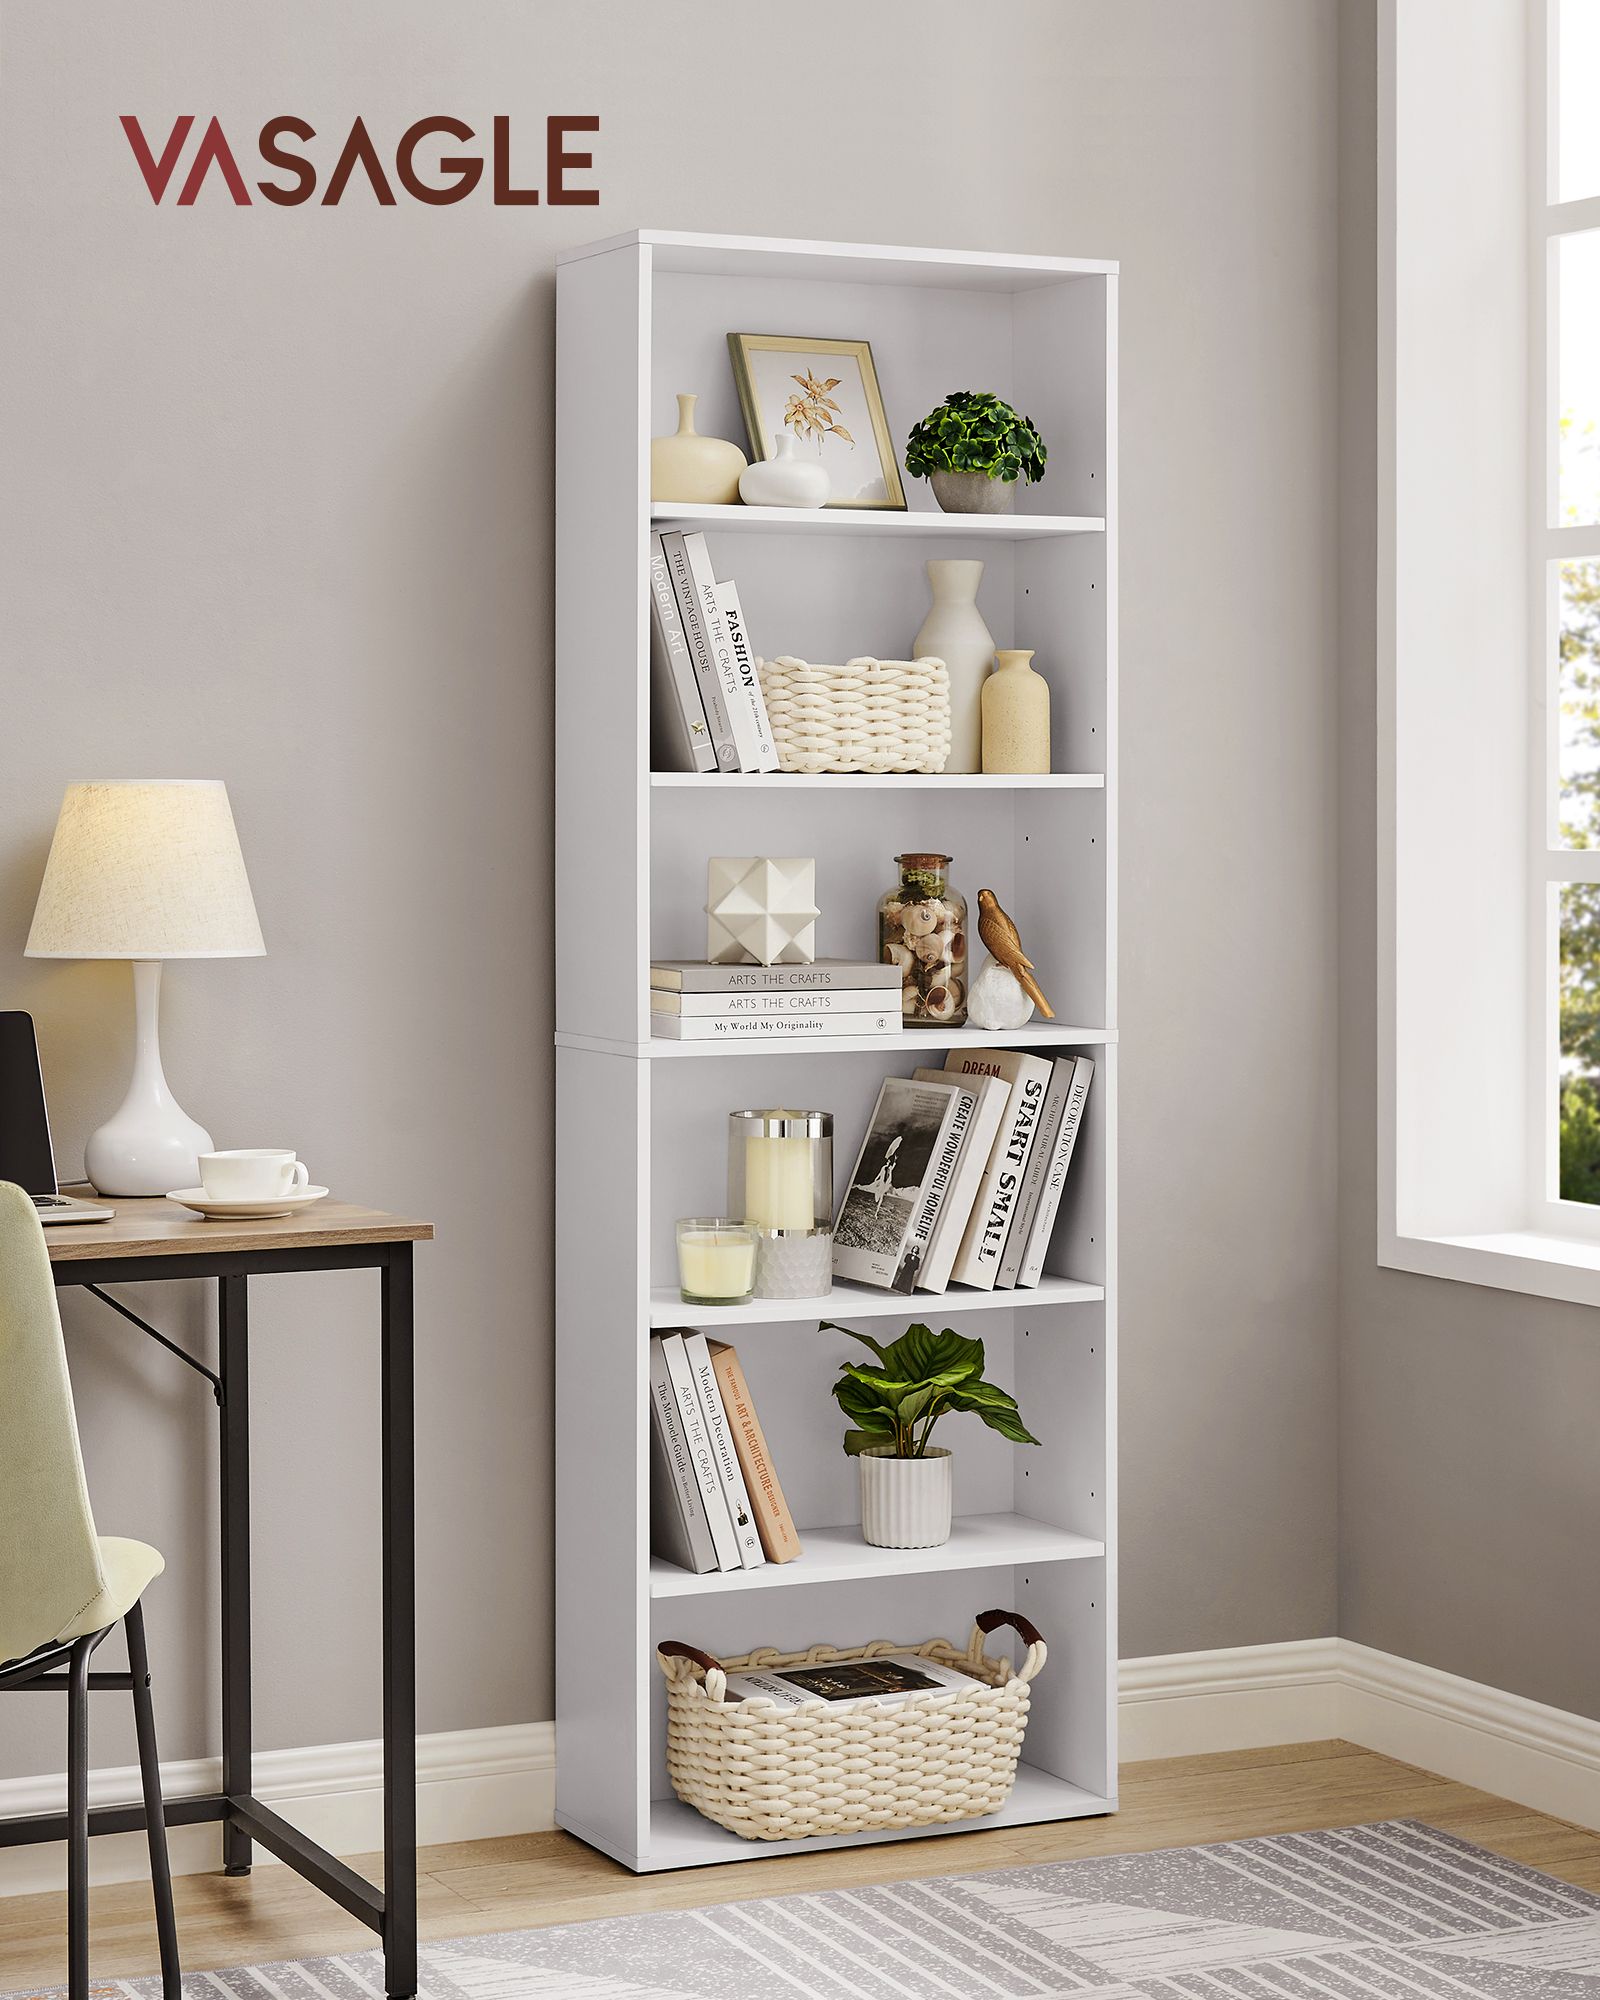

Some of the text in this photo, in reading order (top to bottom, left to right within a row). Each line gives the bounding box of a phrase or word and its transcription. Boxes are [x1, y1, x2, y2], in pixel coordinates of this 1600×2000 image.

[650, 555, 684, 654] Modern Art
[673, 551, 710, 673] THE VINTAGE HOUSE
[702, 584, 738, 693] ARTS THE CRAFTS
[726, 610, 755, 687] FASHION
[729, 973, 831, 985] ARTS THE CRAFTS
[729, 997, 831, 1008] ARTS THE CRAFTS
[715, 1020, 823, 1031] My World My Originality
[962, 1061, 1001, 1078] DREAM
[1038, 1096, 1059, 1159] ARCHITECTURAL
[1058, 1084, 1085, 1159] DECORATION
[915, 1096, 973, 1241] CREATE WONDERFUL HOMELIFE
[978, 1079, 1043, 1263] START SMALL
[1031, 1161, 1042, 1185] GUIDE
[1050, 1162, 1065, 1191] CASE
[657, 1382, 667, 1401] The
[663, 1402, 679, 1443] Monocle
[674, 1443, 686, 1473] Guide
[681, 1386, 717, 1494] ARTS THE CRAFTS
[699, 1366, 734, 1482] Modern Decoration
[725, 1367, 780, 1517] THE FAMOUS ART & ARCHITECTURE DESIGNER
